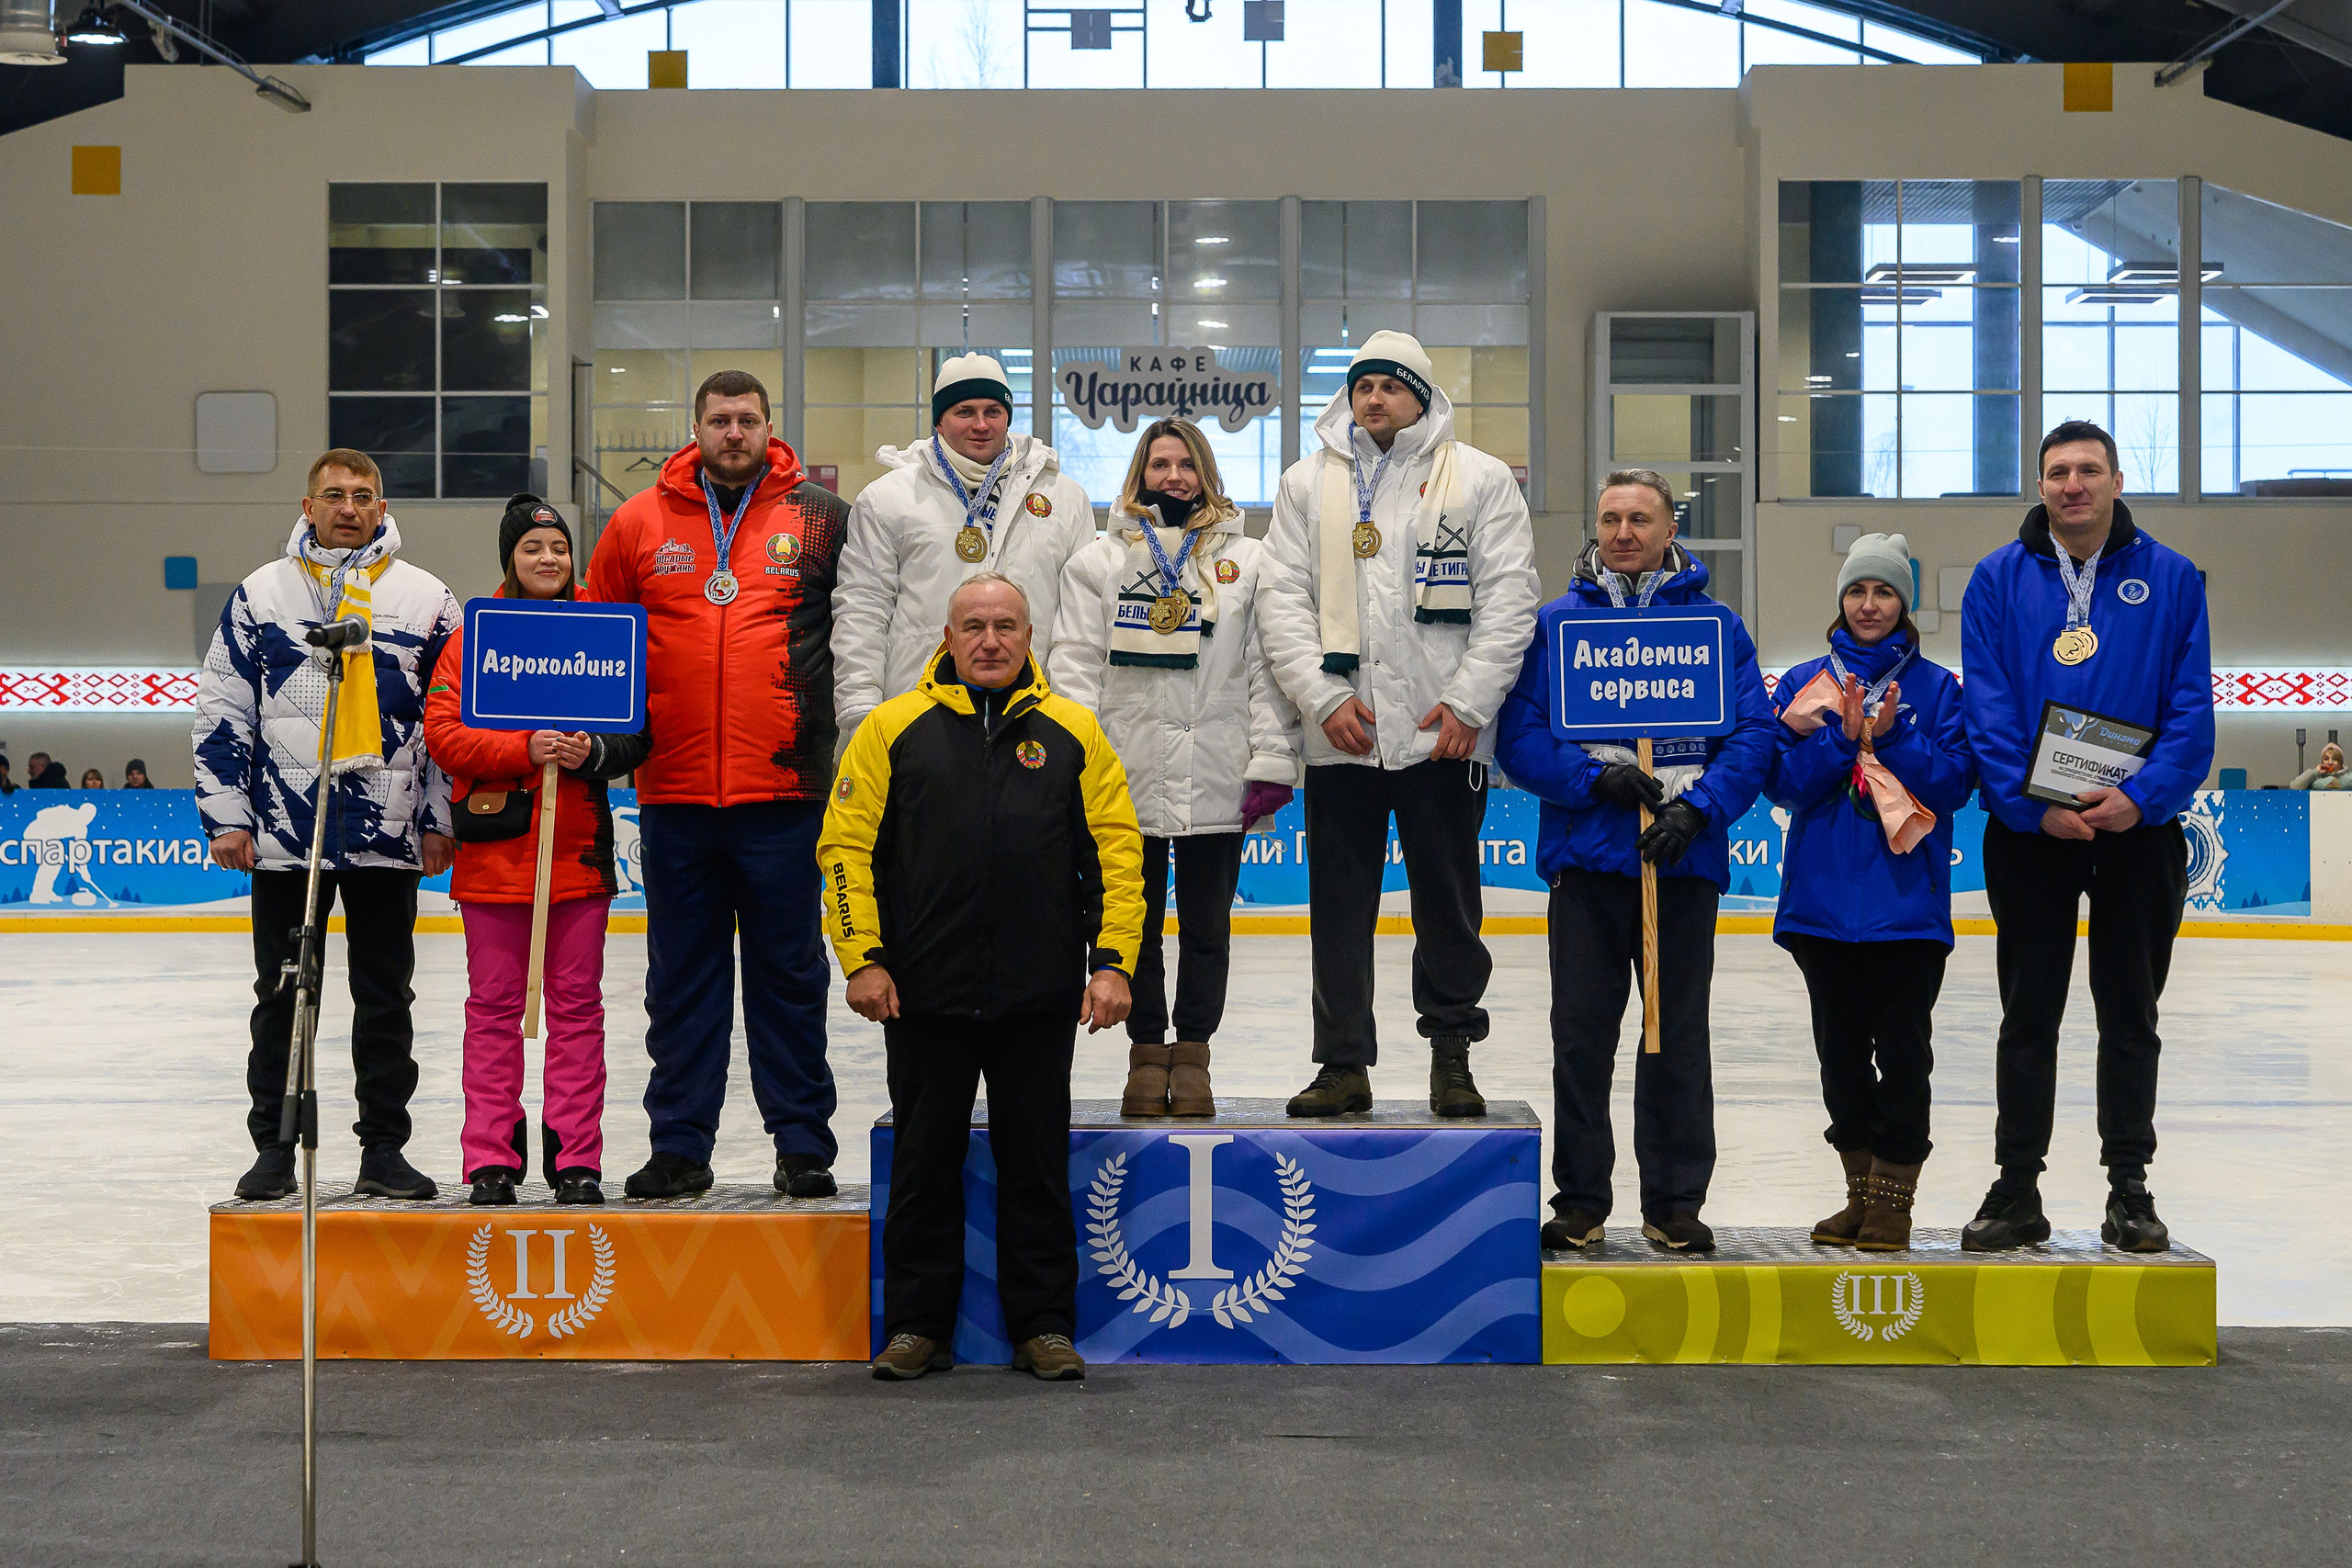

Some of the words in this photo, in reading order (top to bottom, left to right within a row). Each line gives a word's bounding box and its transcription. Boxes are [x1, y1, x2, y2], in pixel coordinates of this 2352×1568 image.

[1130, 355, 1206, 372] КАФЕ
[1065, 370, 1272, 423] Чараўніца
[1396, 367, 1430, 400] БЕЛАРУСЬ
[655, 554, 695, 565] Щедрые
[764, 566, 799, 578] BELARUS
[1441, 561, 1468, 576] ТИГР
[1117, 604, 1150, 621] БЕЛЫ
[482, 649, 626, 681] Агрохолдинг
[1574, 637, 1710, 670] Академия
[1590, 678, 1695, 708] сервиса
[2052, 750, 2128, 780] СЕРТИФИКАТ
[832, 862, 855, 939] BELARUS
